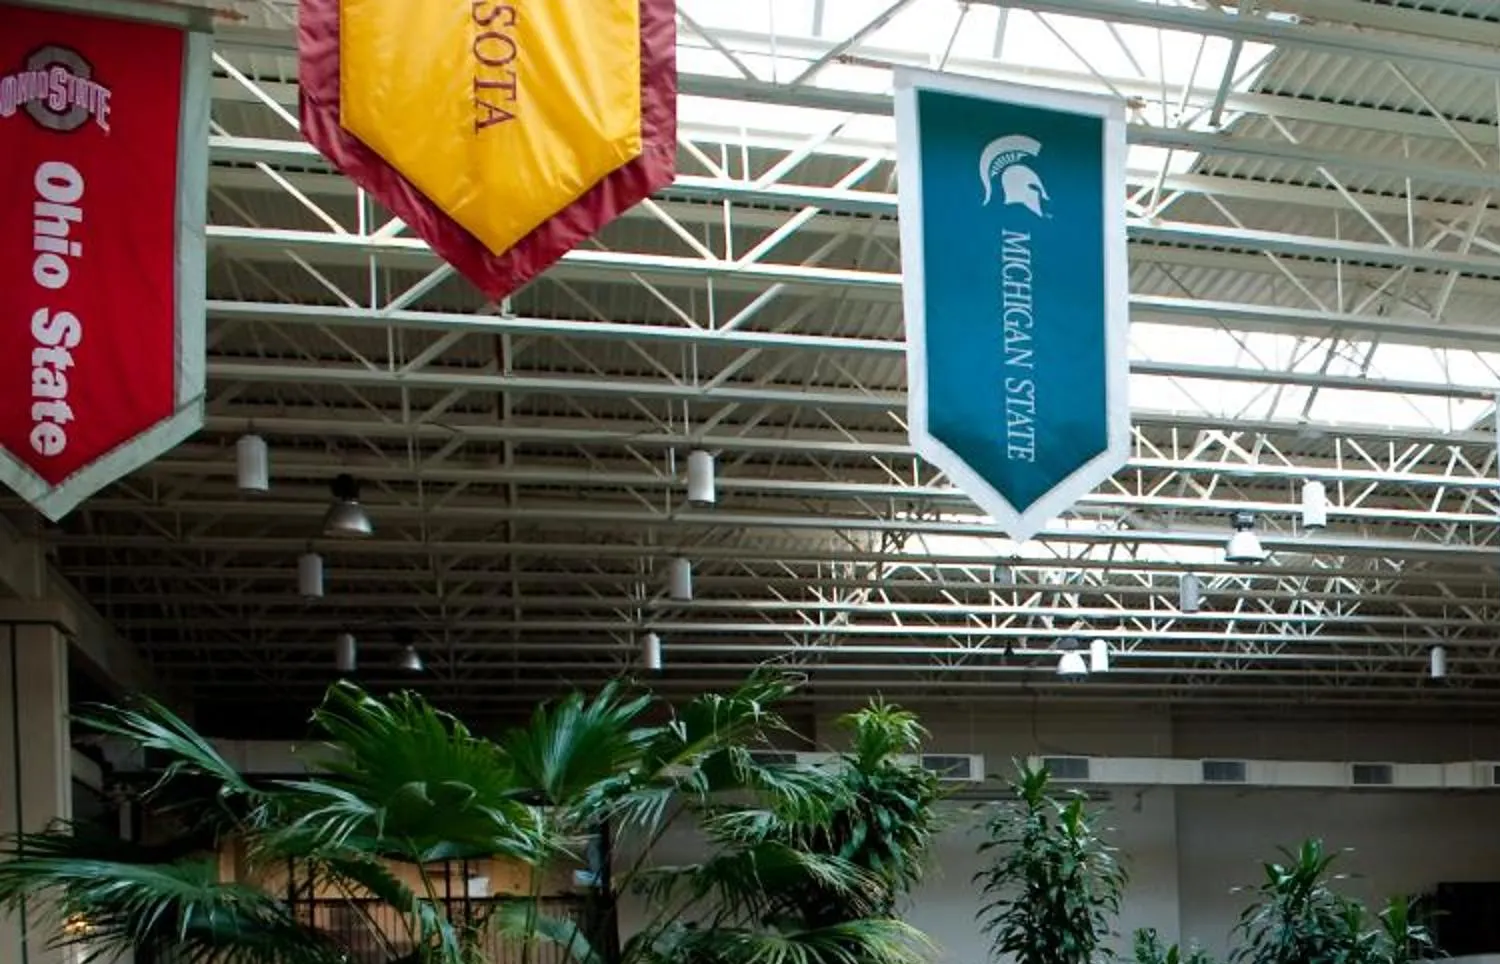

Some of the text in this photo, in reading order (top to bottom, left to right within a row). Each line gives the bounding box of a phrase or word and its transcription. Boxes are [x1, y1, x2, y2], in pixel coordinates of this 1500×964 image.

[29, 160, 85, 457] Ohio State
[1001, 228, 1037, 464] MICHIGAN STATE
